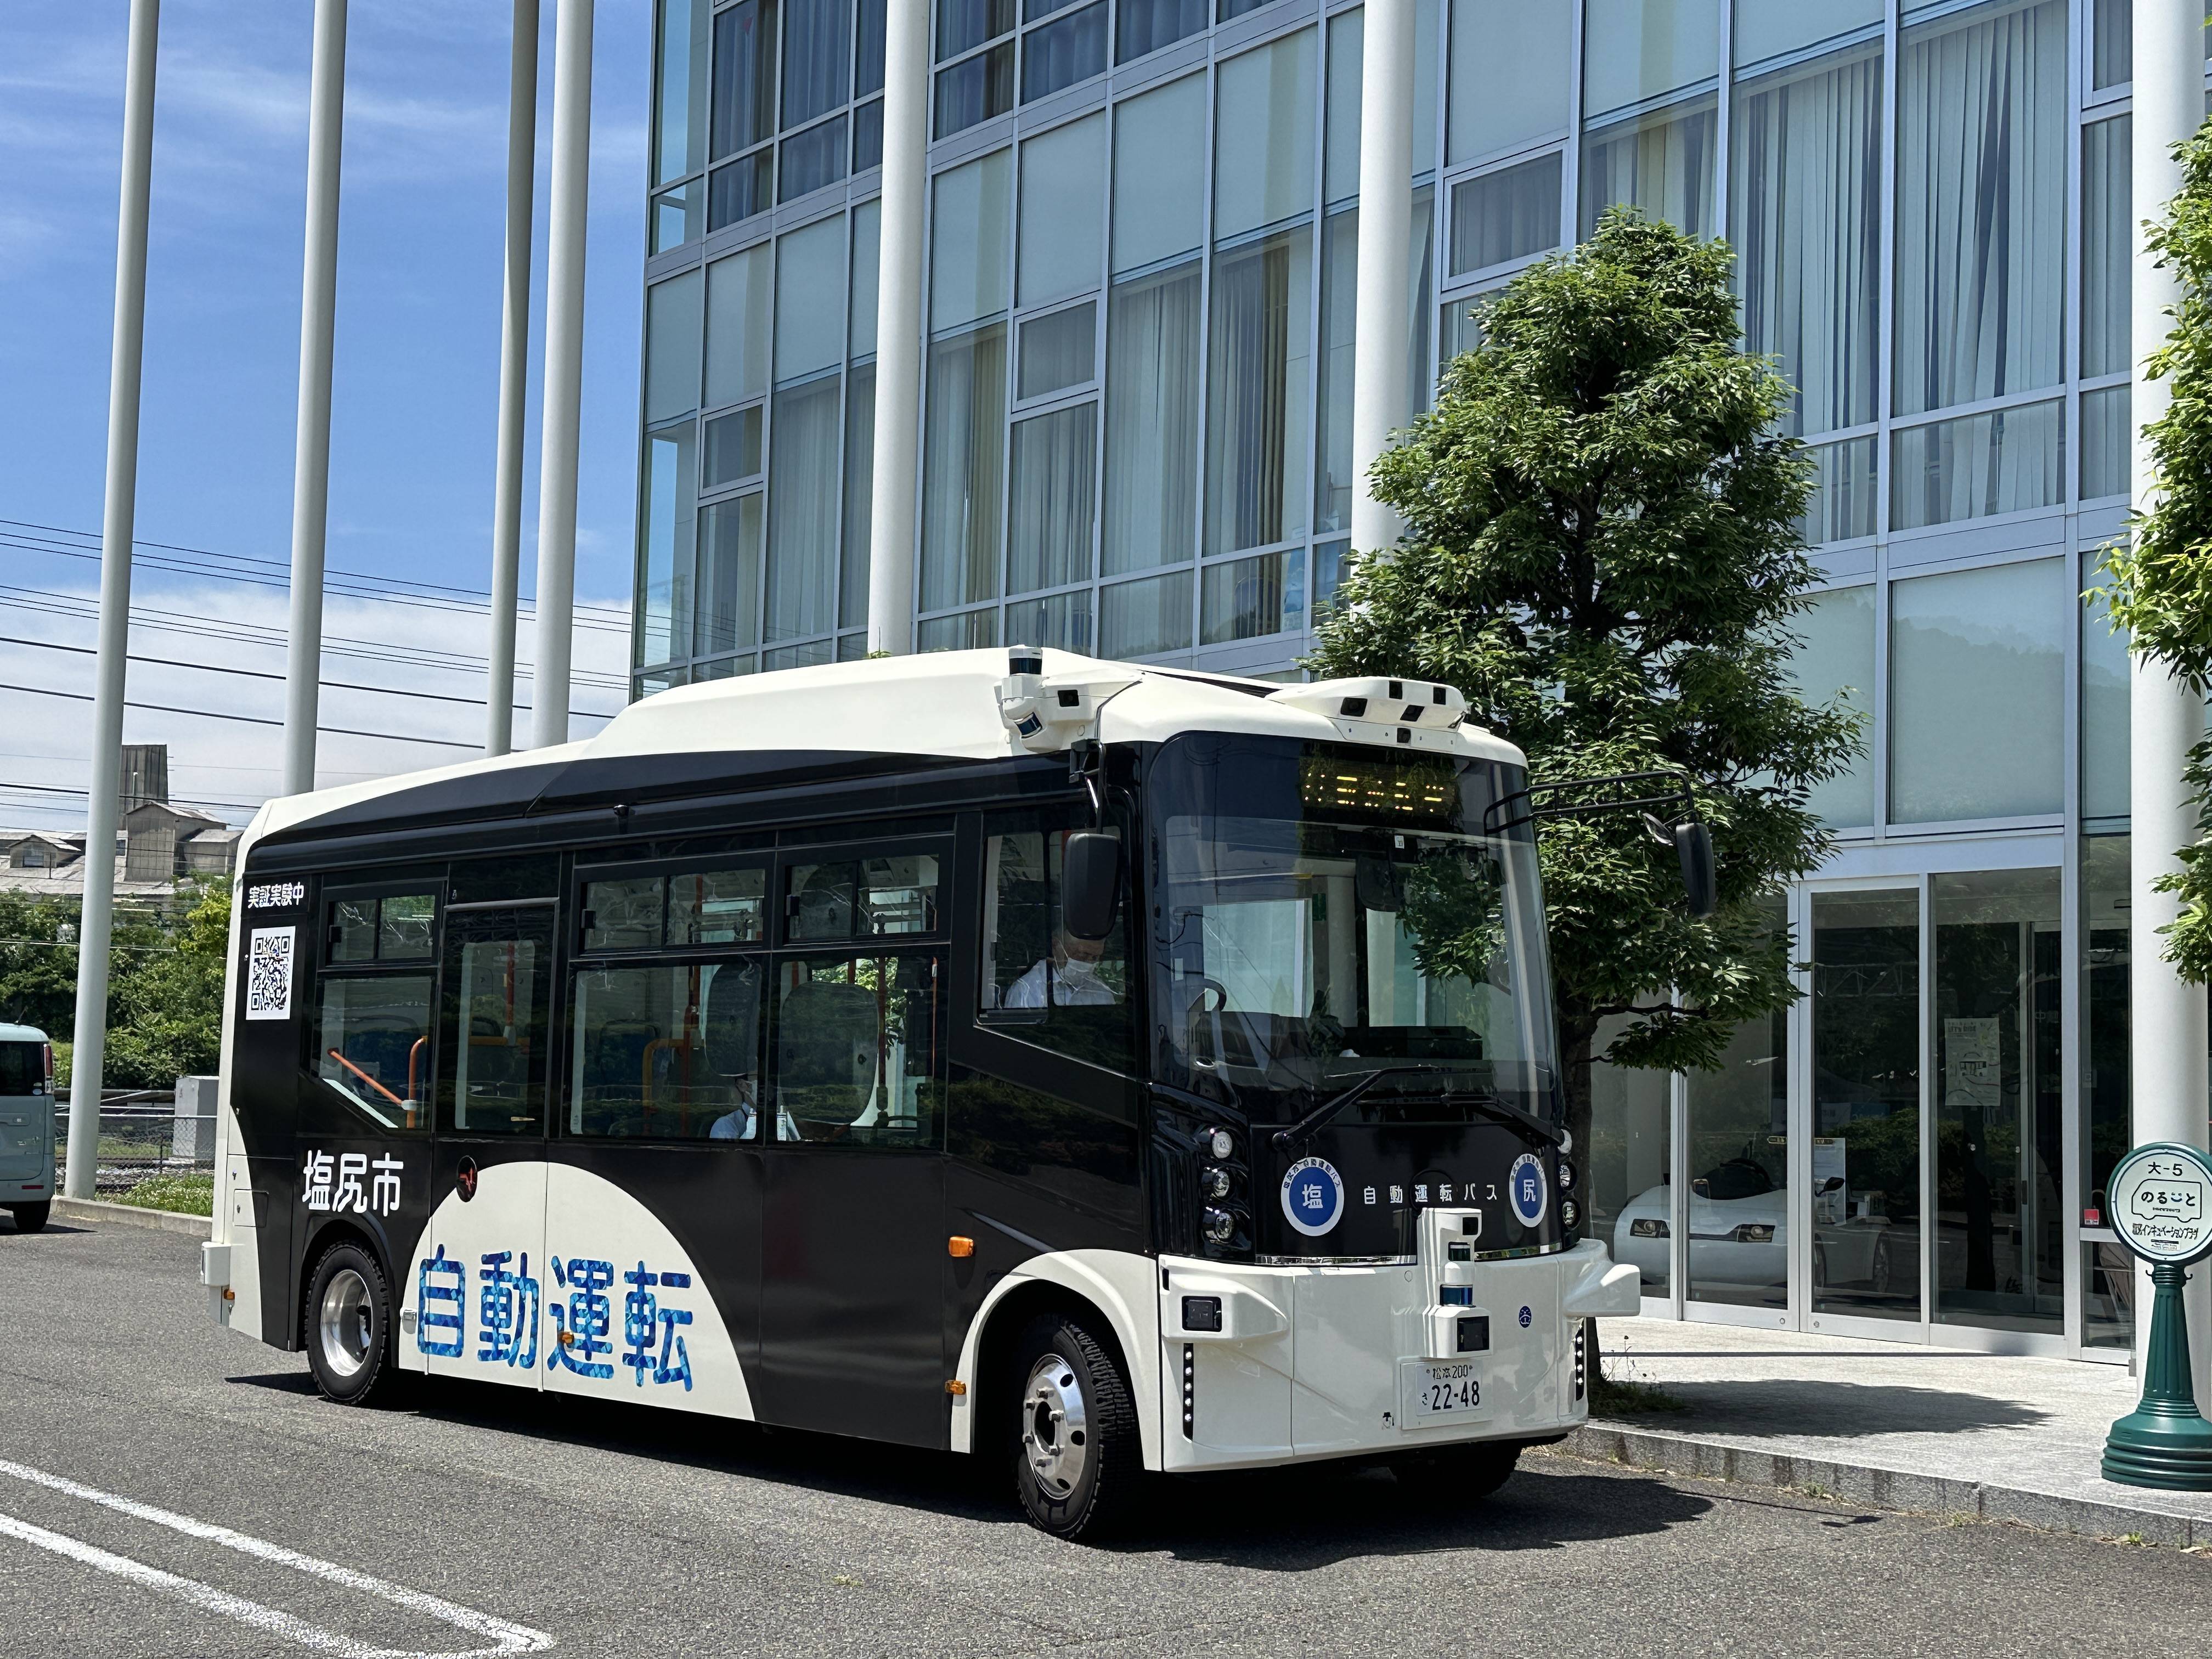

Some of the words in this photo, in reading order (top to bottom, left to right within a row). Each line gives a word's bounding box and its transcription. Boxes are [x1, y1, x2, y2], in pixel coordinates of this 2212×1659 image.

[302, 1149, 404, 1217] 塩尻市
[1302, 1183, 1323, 1209] 塩
[1363, 1183, 1498, 1204] 自動運転バス
[1523, 1179, 1536, 1202] 尻
[417, 1244, 693, 1392] 自動運転
[1431, 1380, 1480, 1410] 22-48
